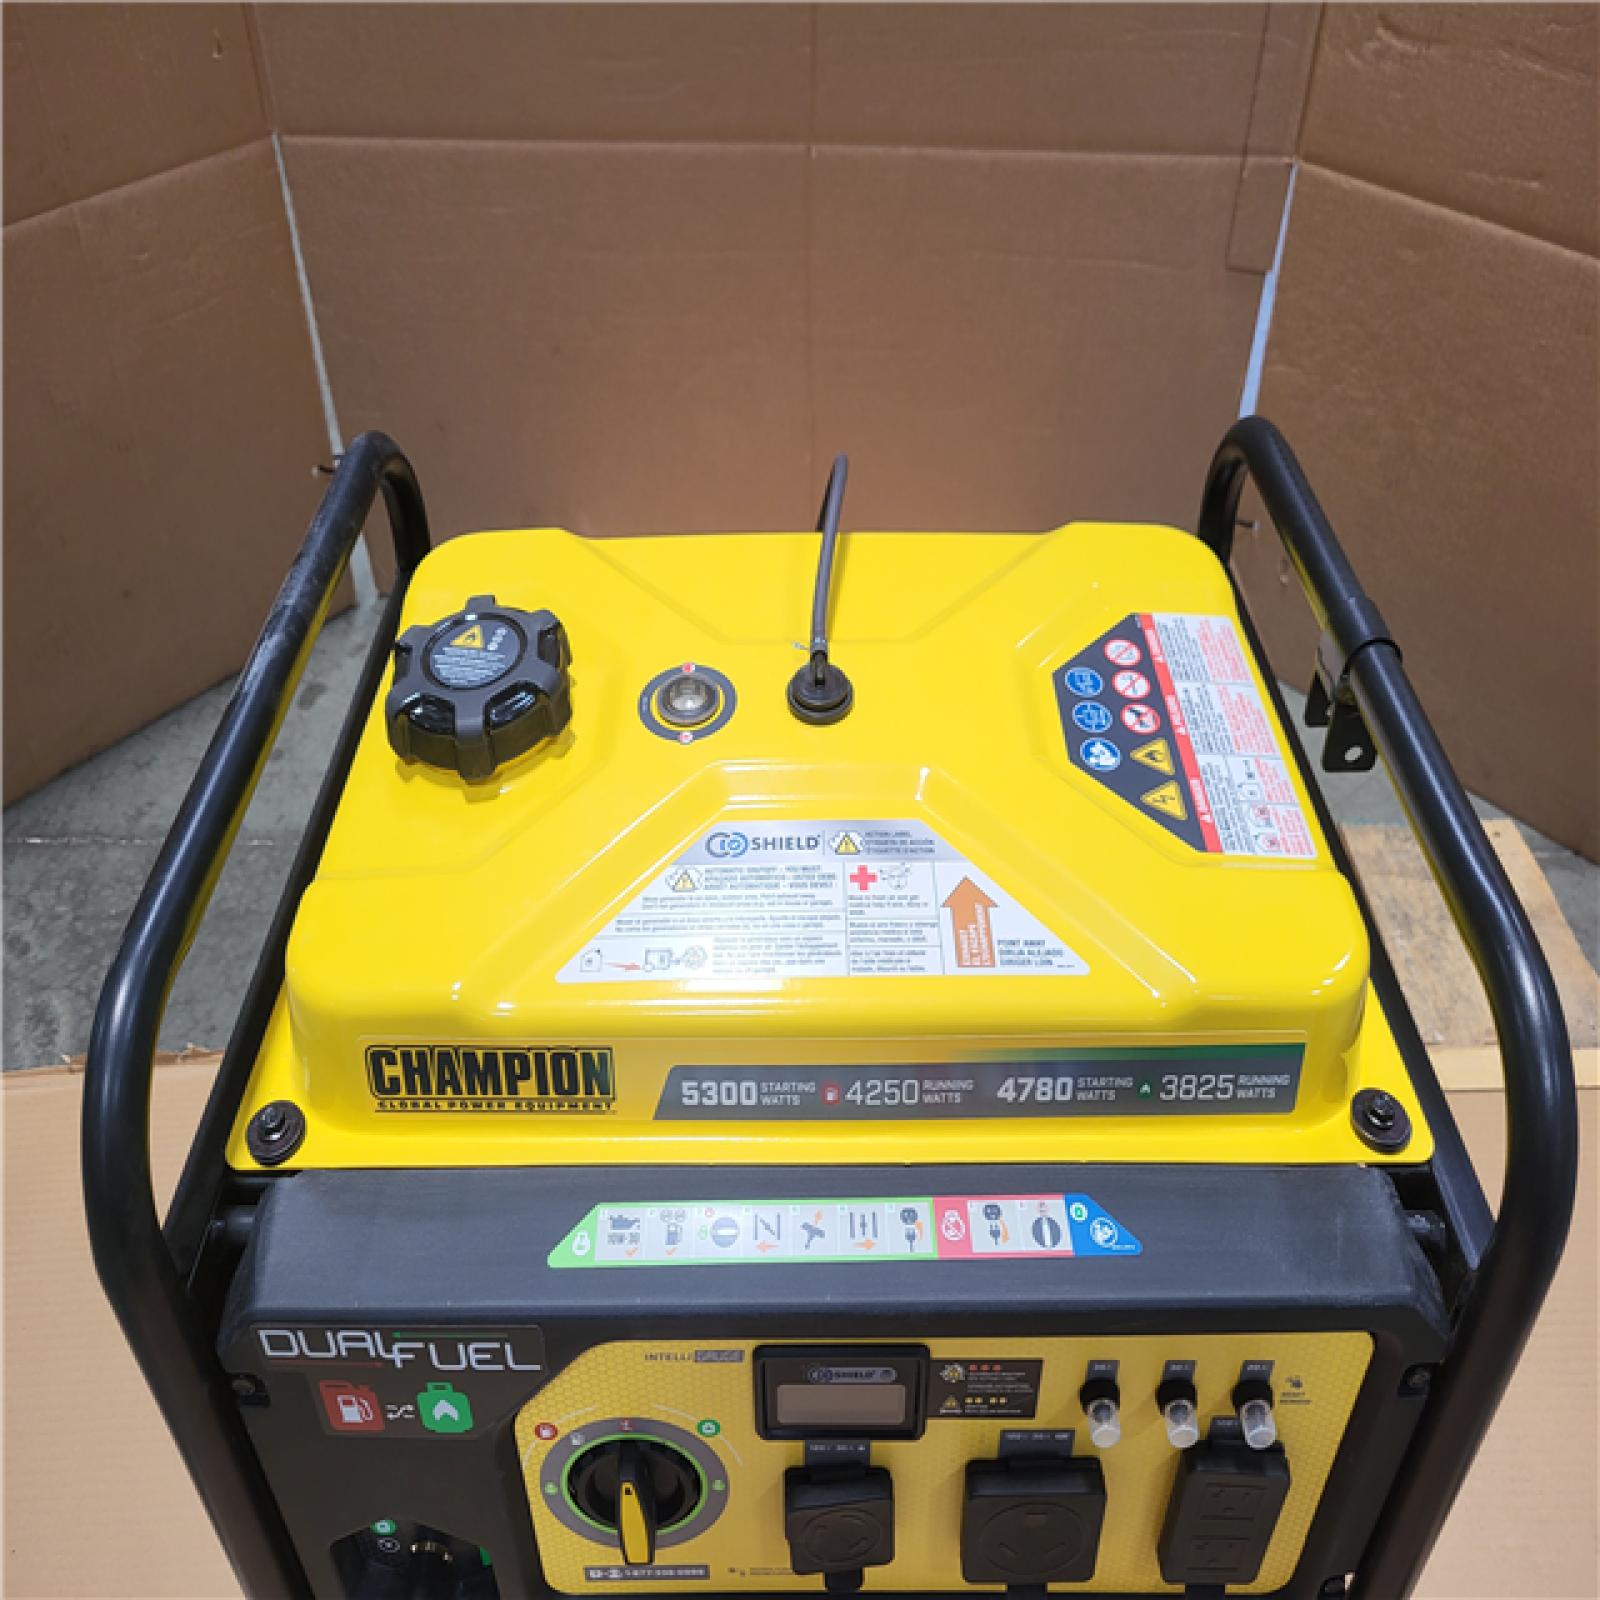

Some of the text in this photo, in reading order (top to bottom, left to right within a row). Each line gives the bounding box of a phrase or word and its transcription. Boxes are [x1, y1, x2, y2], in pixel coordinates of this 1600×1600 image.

[370, 1050, 612, 1096] CHAMPION
[681, 1081, 816, 1106] 5300 STARTING
[845, 1080, 974, 1106] 4250 RUNNING
[922, 1092, 962, 1104] WATTS
[997, 1077, 1133, 1102] 4780 STARTING
[1076, 1090, 1116, 1101] WATTS
[1160, 1074, 1291, 1100] 3825 RUNNING
[1237, 1087, 1276, 1099] WATTS
[760, 1095, 801, 1106] WATTS
